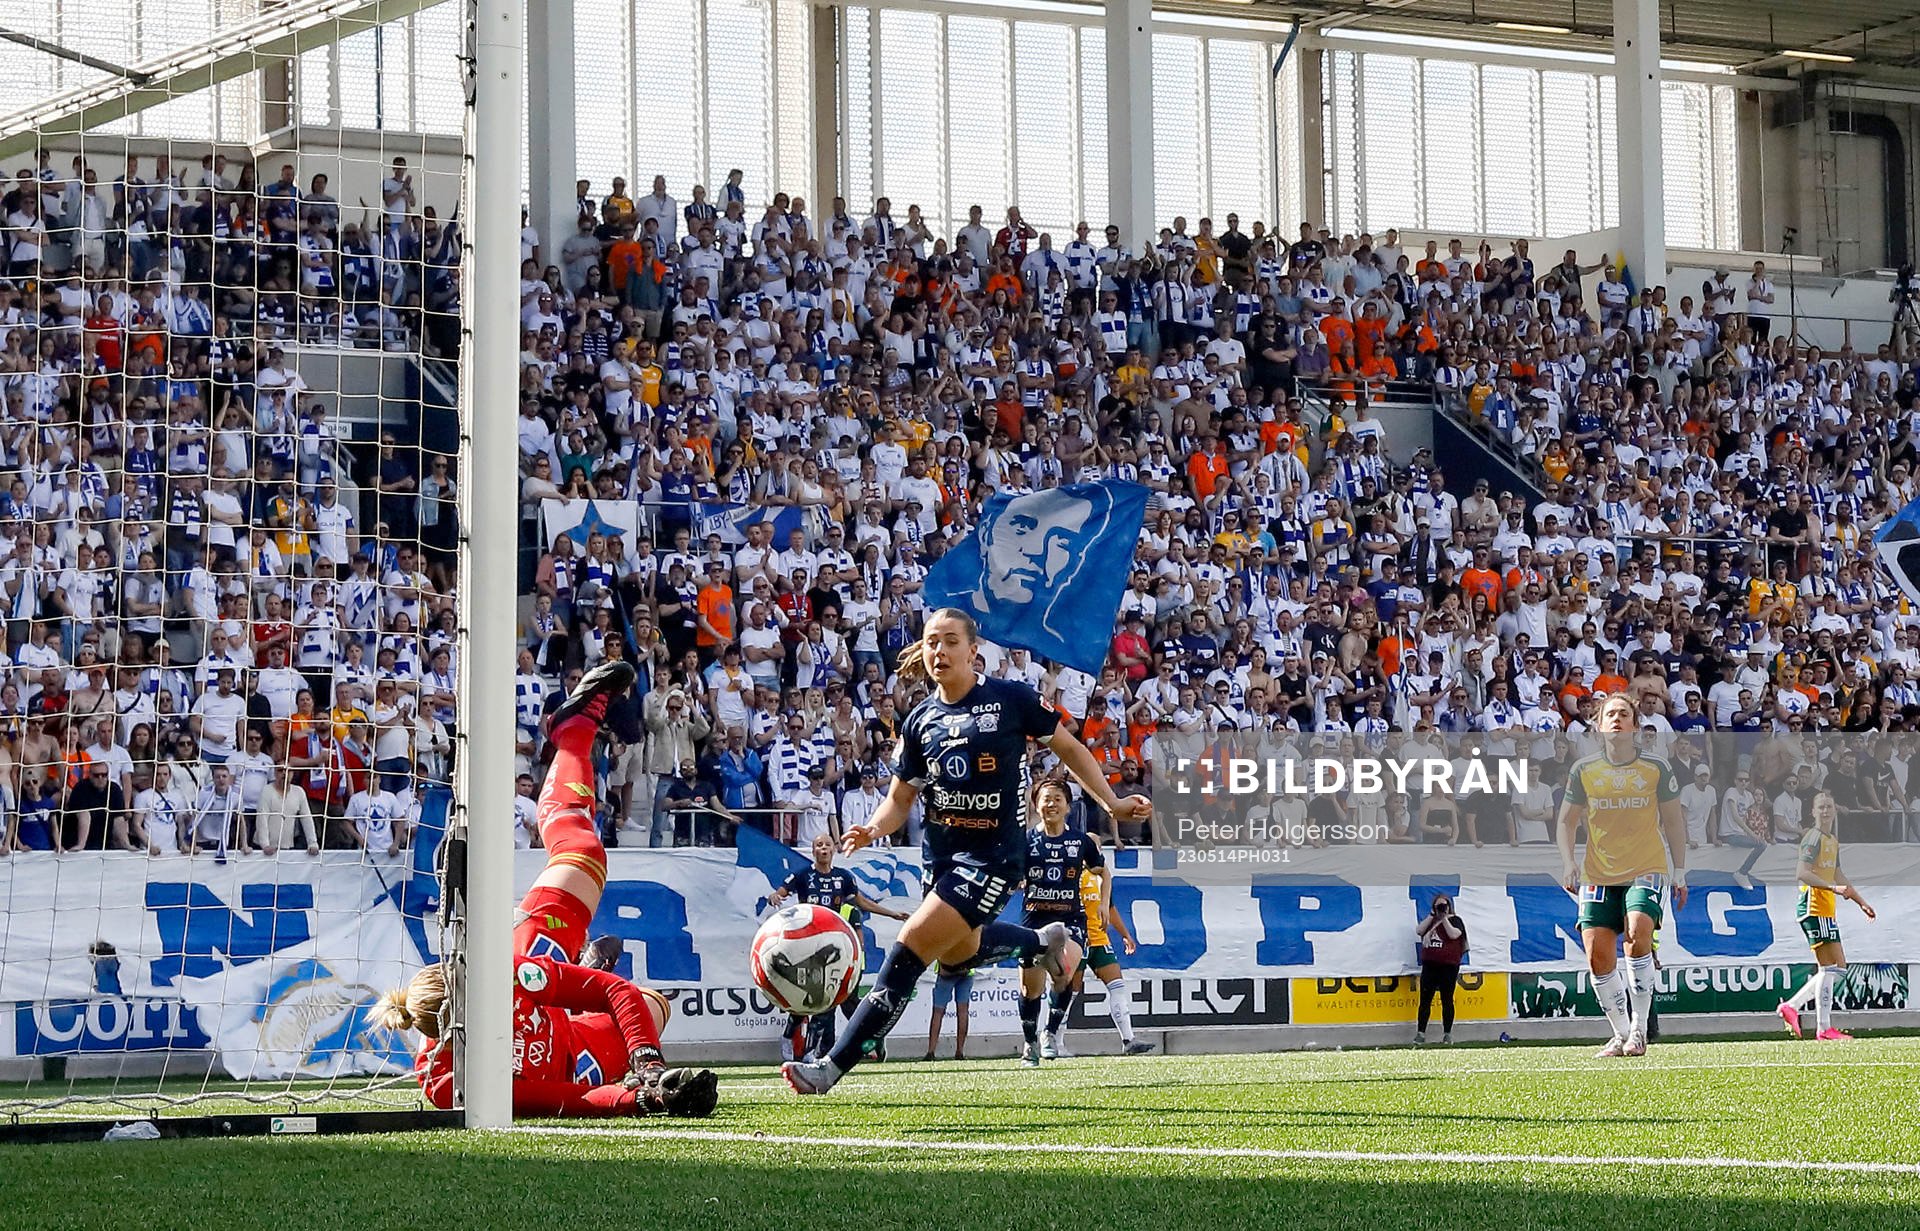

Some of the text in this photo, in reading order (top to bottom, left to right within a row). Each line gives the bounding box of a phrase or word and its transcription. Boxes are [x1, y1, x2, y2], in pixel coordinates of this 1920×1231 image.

[940, 737, 969, 748] unisport
[1593, 796, 1650, 809] HOLMEN
[1037, 888, 1075, 900] Botrygg
[826, 968, 840, 991] LFC
[970, 987, 1019, 1001] ervice
[32, 995, 189, 1042] Corr
[770, 1017, 787, 1026] Pap
